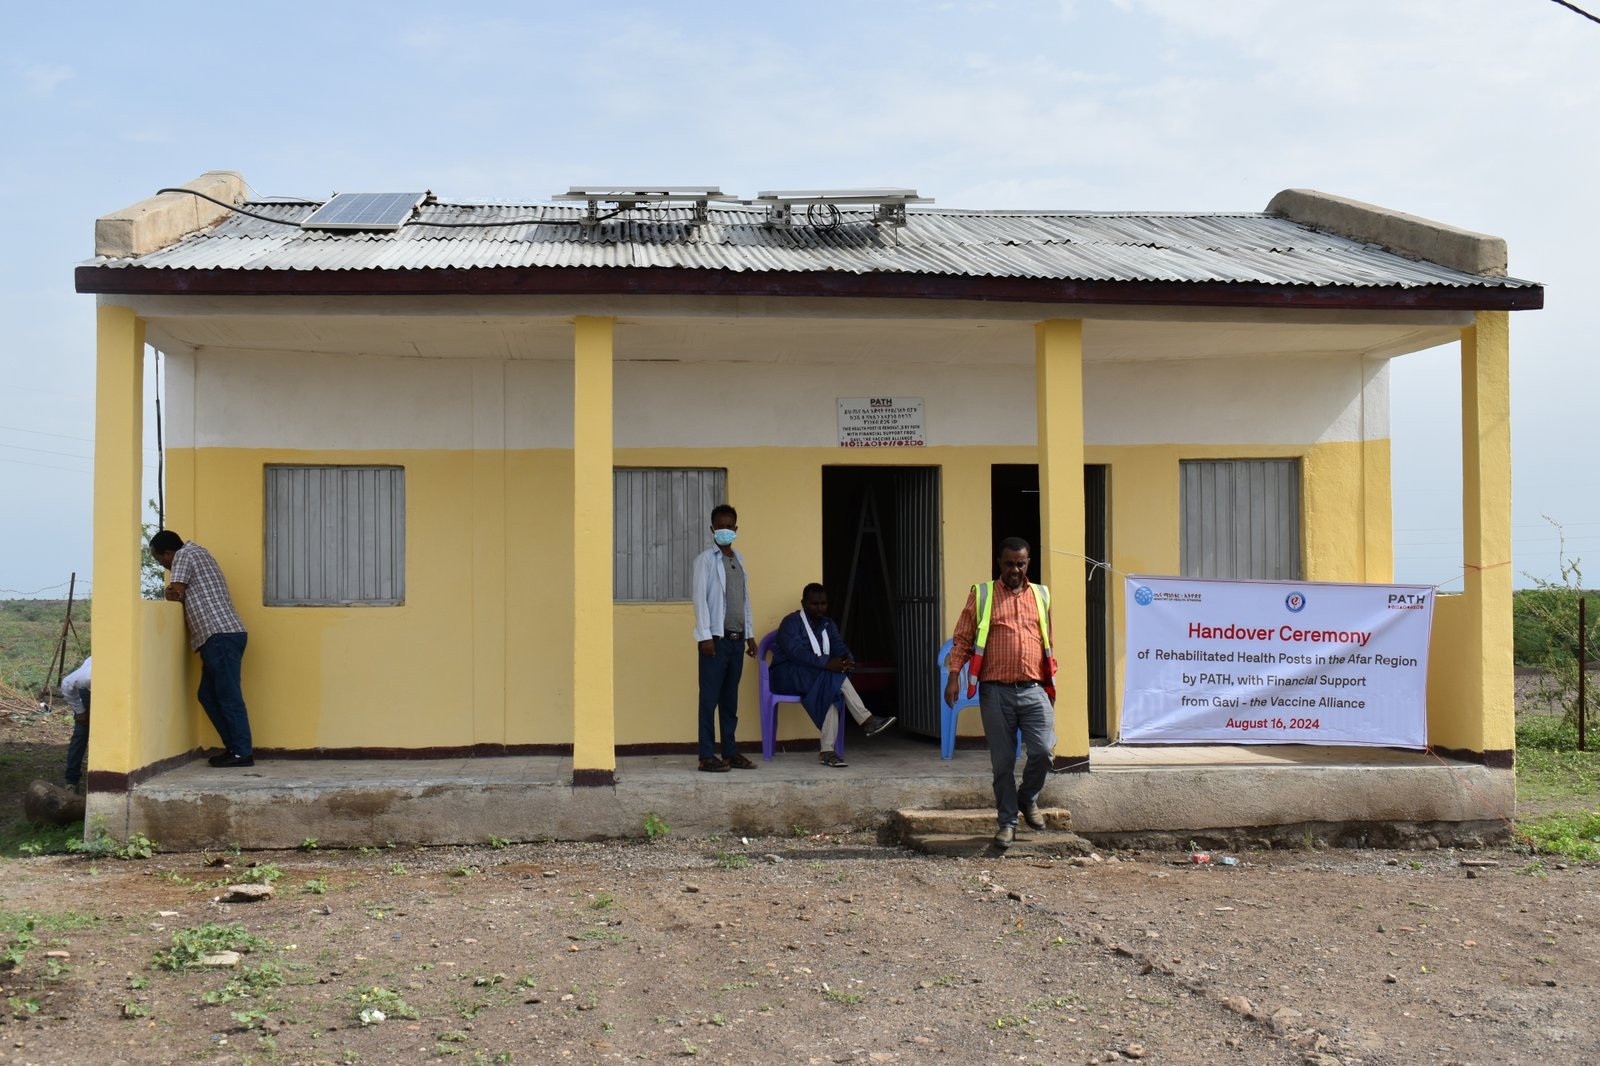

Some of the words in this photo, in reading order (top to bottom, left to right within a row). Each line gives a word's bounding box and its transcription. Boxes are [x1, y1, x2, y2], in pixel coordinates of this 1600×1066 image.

[1388, 594, 1425, 604] PATH
[1189, 622, 1275, 641] Handover
[1279, 625, 1372, 647] Ceremony
[1137, 649, 1150, 660] of
[1155, 649, 1234, 663] Rehabilitated
[1237, 651, 1276, 664] Health
[1278, 653, 1312, 665] Posts
[1315, 654, 1326, 665] in
[1328, 655, 1346, 665] the
[1347, 654, 1372, 665] Afar
[1374, 654, 1418, 668] Region
[1182, 673, 1197, 687] by
[1199, 673, 1235, 686] PATH,
[1237, 675, 1264, 686] with
[1267, 675, 1318, 687] Financial
[1320, 675, 1367, 688] Support
[1181, 696, 1209, 707] from
[1212, 696, 1239, 708] Gavi
[1250, 697, 1268, 707] the
[1270, 696, 1316, 708] Vaccine
[1318, 697, 1366, 709] Alliance
[1225, 718, 1268, 731] August
[1271, 718, 1286, 730] 16,
[1289, 718, 1320, 730] 2024
